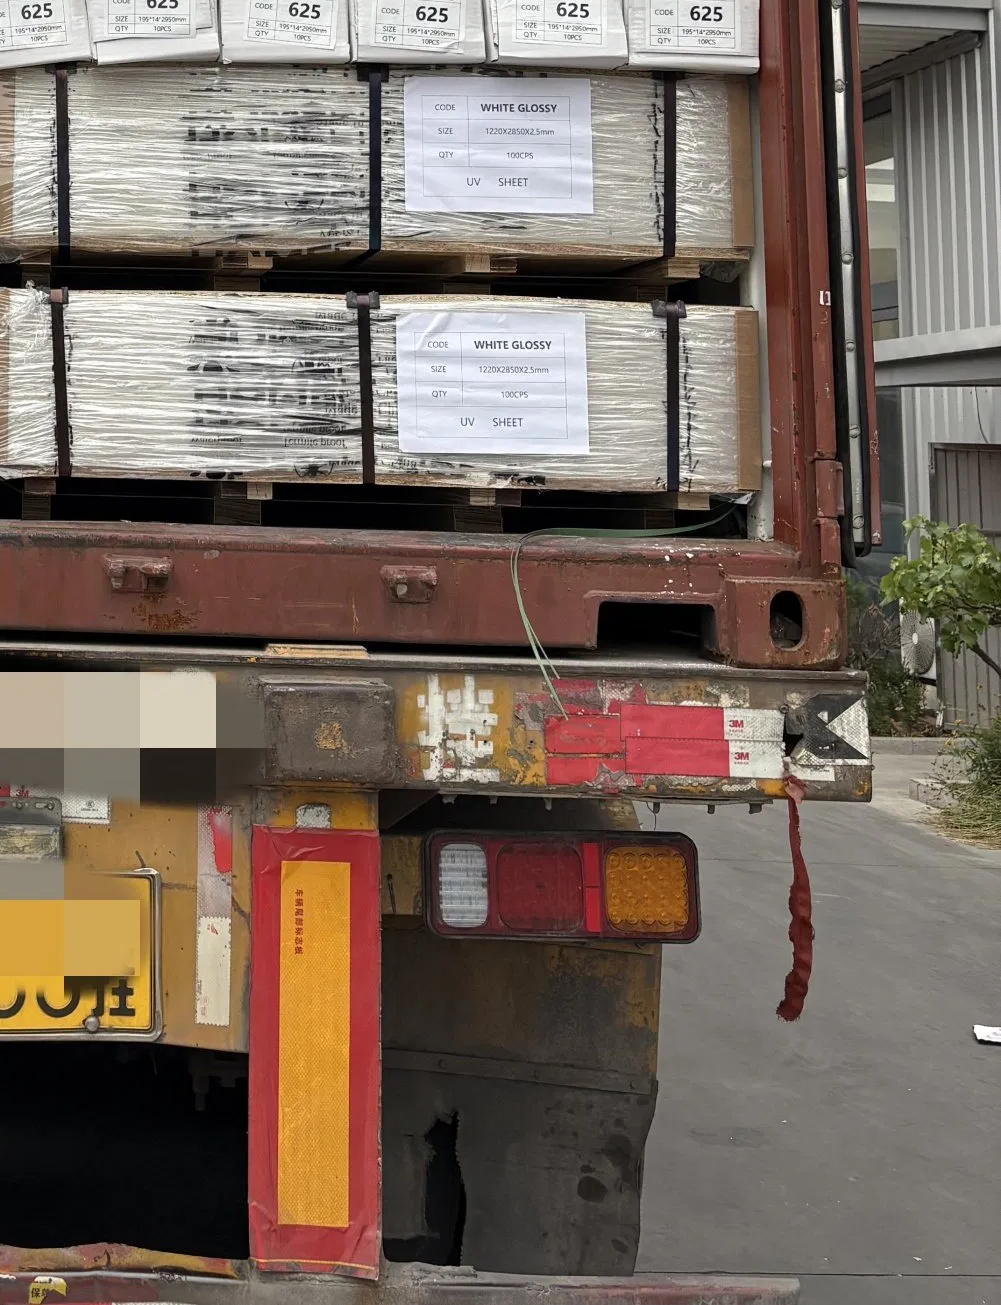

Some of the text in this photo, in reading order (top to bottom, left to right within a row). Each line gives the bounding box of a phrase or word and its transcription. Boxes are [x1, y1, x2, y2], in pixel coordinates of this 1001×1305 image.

[416, 6, 448, 23] 625
[690, 6, 723, 22] 625
[657, 27, 672, 35] SIZE
[697, 38, 717, 46] 10PCS
[434, 103, 558, 113] CODE WHITE GLOSSY
[438, 127, 555, 136] SIZE 1220X2850X2.5mm
[438, 151, 454, 159] QTY
[466, 177, 528, 187] UV SHEET
[473, 340, 509, 350] WHITE
[512, 340, 552, 350] GLOSSY
[430, 365, 549, 374] SIZE 1220X2850X2.5mm
[431, 390, 529, 399] QTY 100CPS
[460, 417, 523, 427] UV SHEET
[728, 719, 744, 728] 3M
[734, 751, 750, 761] 3M
